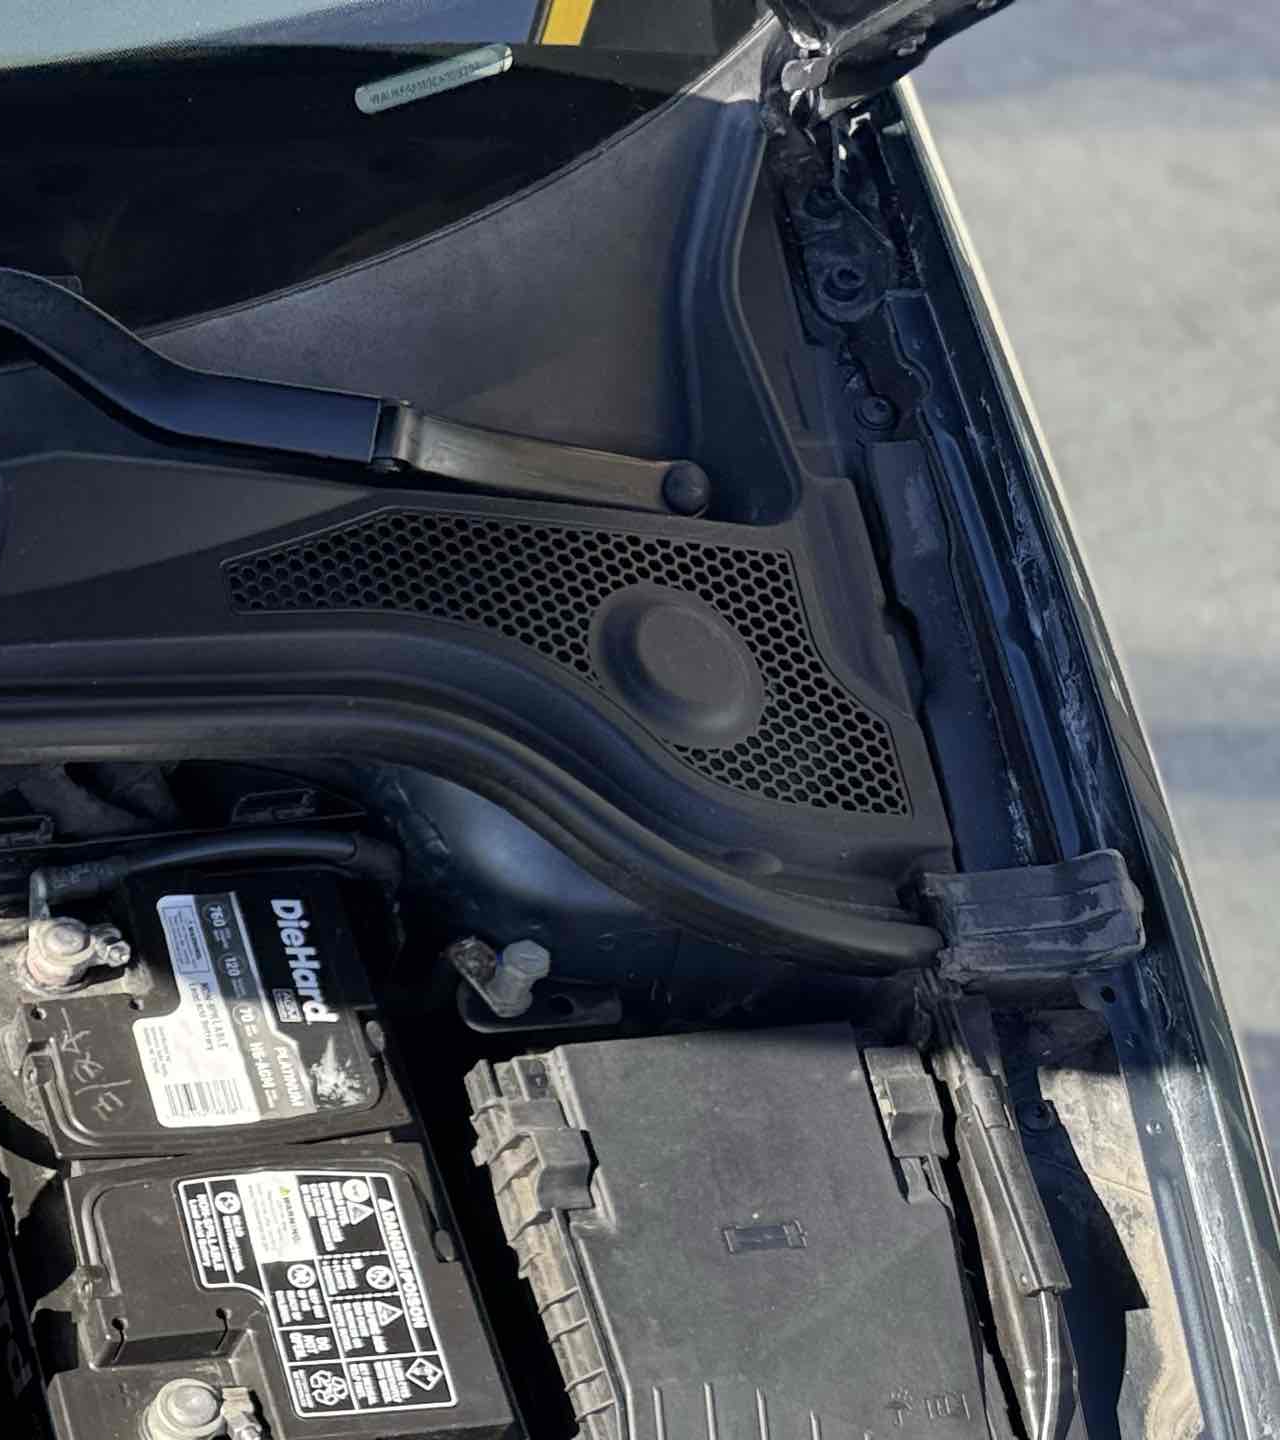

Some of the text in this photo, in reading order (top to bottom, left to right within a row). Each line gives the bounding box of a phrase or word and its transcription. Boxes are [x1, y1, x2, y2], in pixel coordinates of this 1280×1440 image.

[208, 904, 226, 926] 760
[223, 956, 241, 976] 120
[238, 1007, 255, 1022] 70
[270, 897, 340, 1024] DieHard
[273, 1046, 304, 1107] PLATINUM
